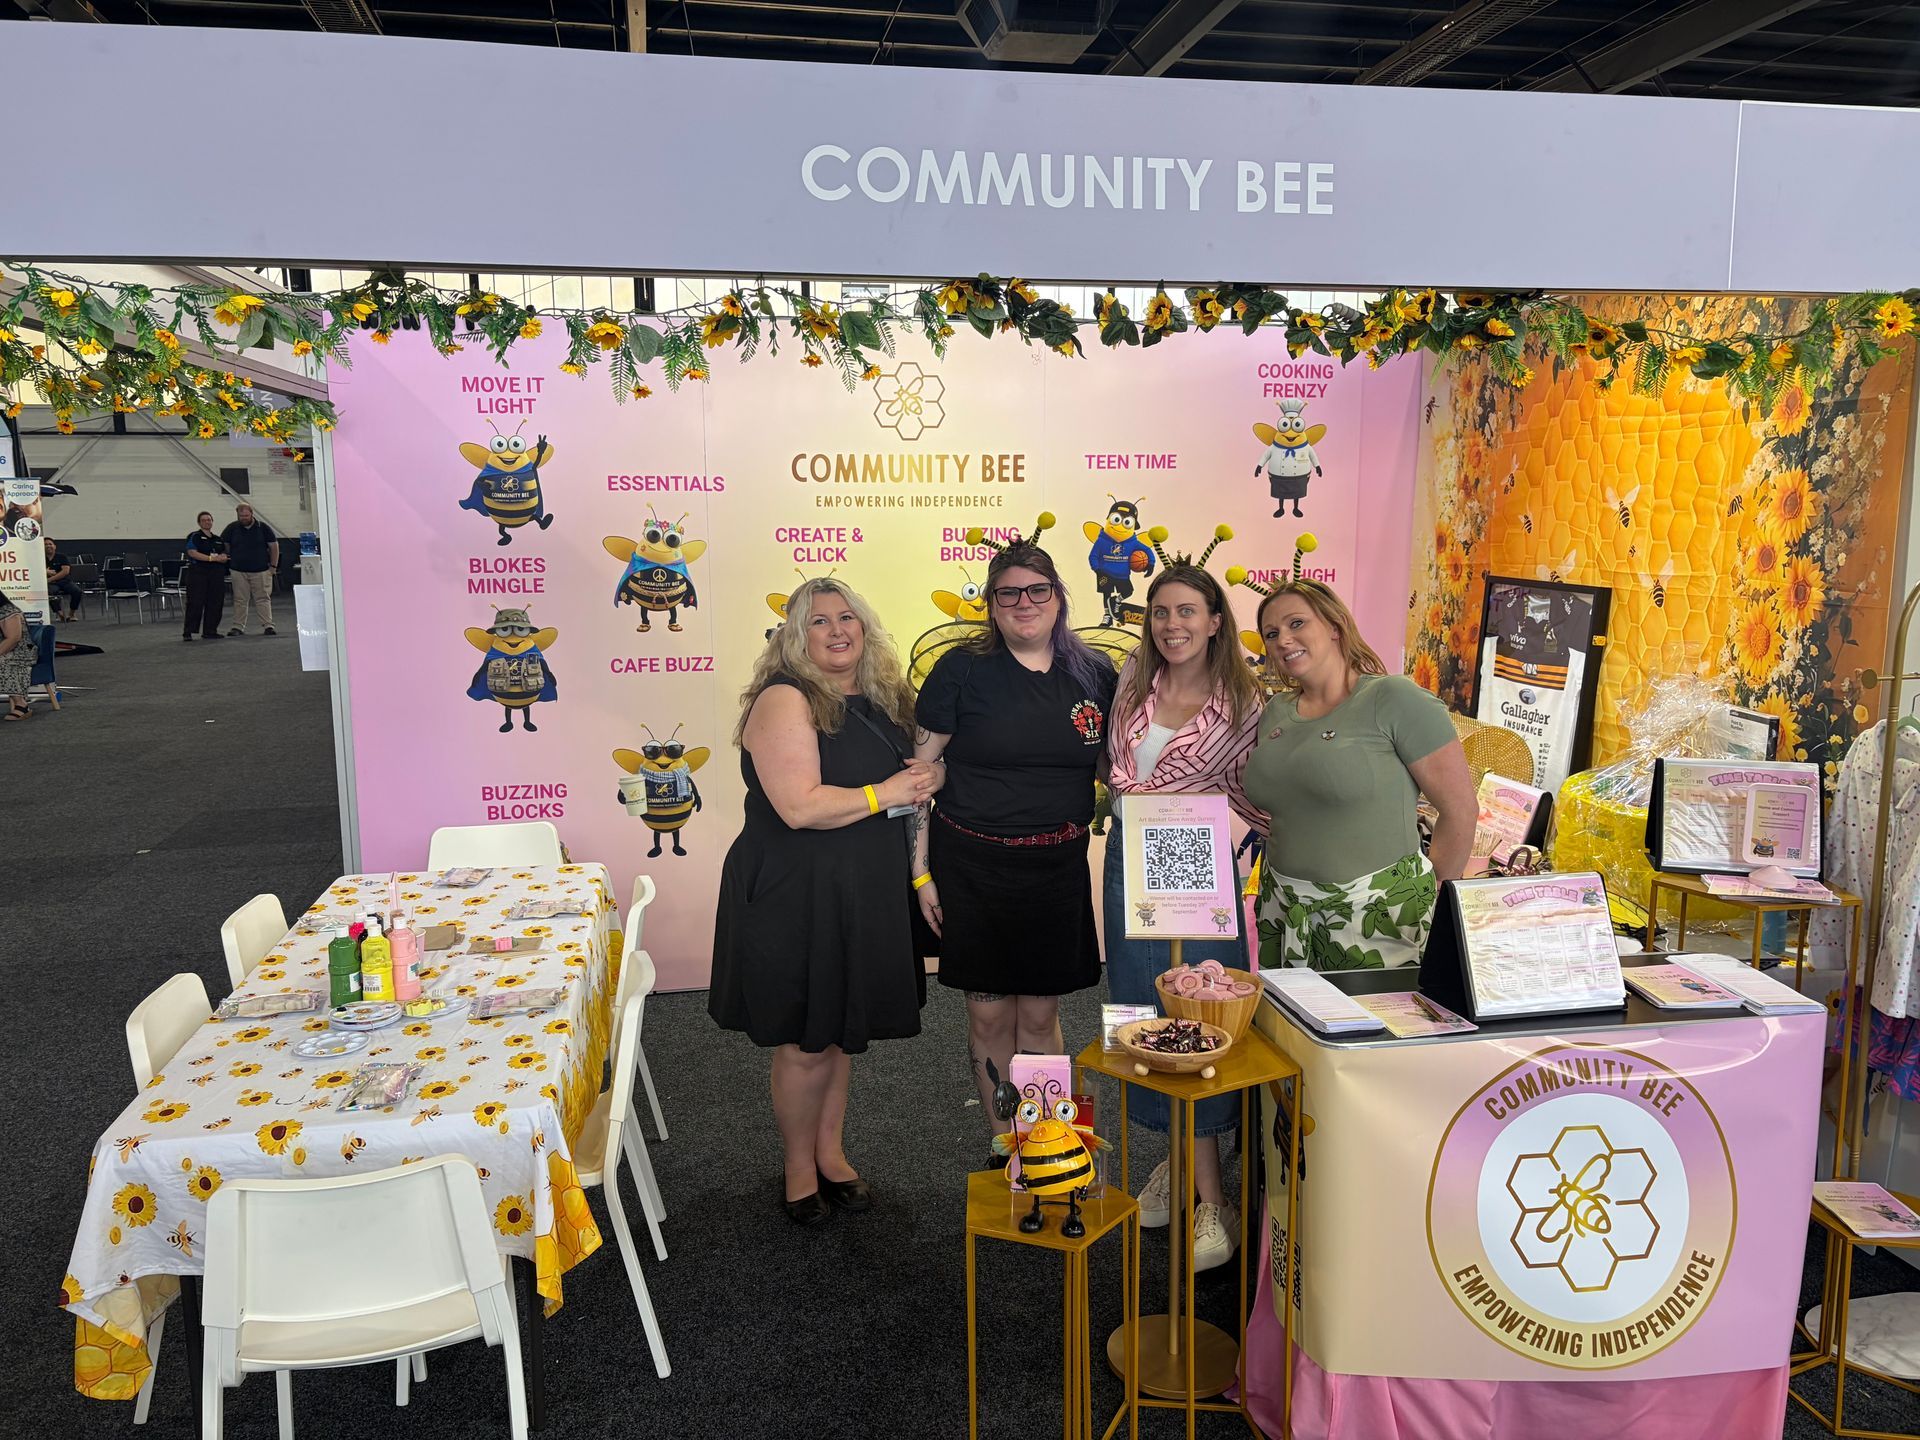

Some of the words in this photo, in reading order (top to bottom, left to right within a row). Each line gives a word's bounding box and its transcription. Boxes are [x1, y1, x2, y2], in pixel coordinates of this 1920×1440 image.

[801, 144, 1213, 212] COMMUNITY
[1237, 160, 1335, 215] BEE
[1257, 363, 1334, 380] COOKING
[461, 376, 521, 394] MOVE
[526, 376, 545, 393] IT
[1263, 382, 1328, 399] FRENZY
[476, 397, 537, 415] LIGHT
[791, 453, 970, 483] COMMUNITY
[981, 453, 1025, 482] BEE
[1085, 454, 1130, 470] TEEN
[1134, 454, 1177, 470] TIME
[12, 483, 34, 491] Caring
[607, 475, 724, 492] ESSENTIALS
[815, 495, 905, 508] EMPOWERING
[910, 495, 1003, 508] INDEPENDENCE
[775, 527, 844, 543] CREATE
[850, 527, 865, 543] &
[793, 547, 844, 563] CLICK
[469, 557, 545, 574] BLOKES
[467, 577, 544, 593] MINGLE
[611, 657, 659, 673] CAFE
[666, 656, 713, 673] BUZZ
[1500, 701, 1551, 725] Gallagher
[1503, 719, 1543, 737] INSURANCE
[1708, 771, 1744, 787] TIME
[481, 783, 568, 802] BUZZING
[487, 802, 564, 821] BLOCKS
[1502, 886, 1535, 908] TIME
[1534, 885, 1578, 903] TABLE
[1484, 1057, 1634, 1121] COMMUNITY
[1639, 1072, 1685, 1118] BEE
[1453, 1264, 1583, 1357] EMPOWERING
[1591, 1249, 1716, 1358] INDEPENDENCE
